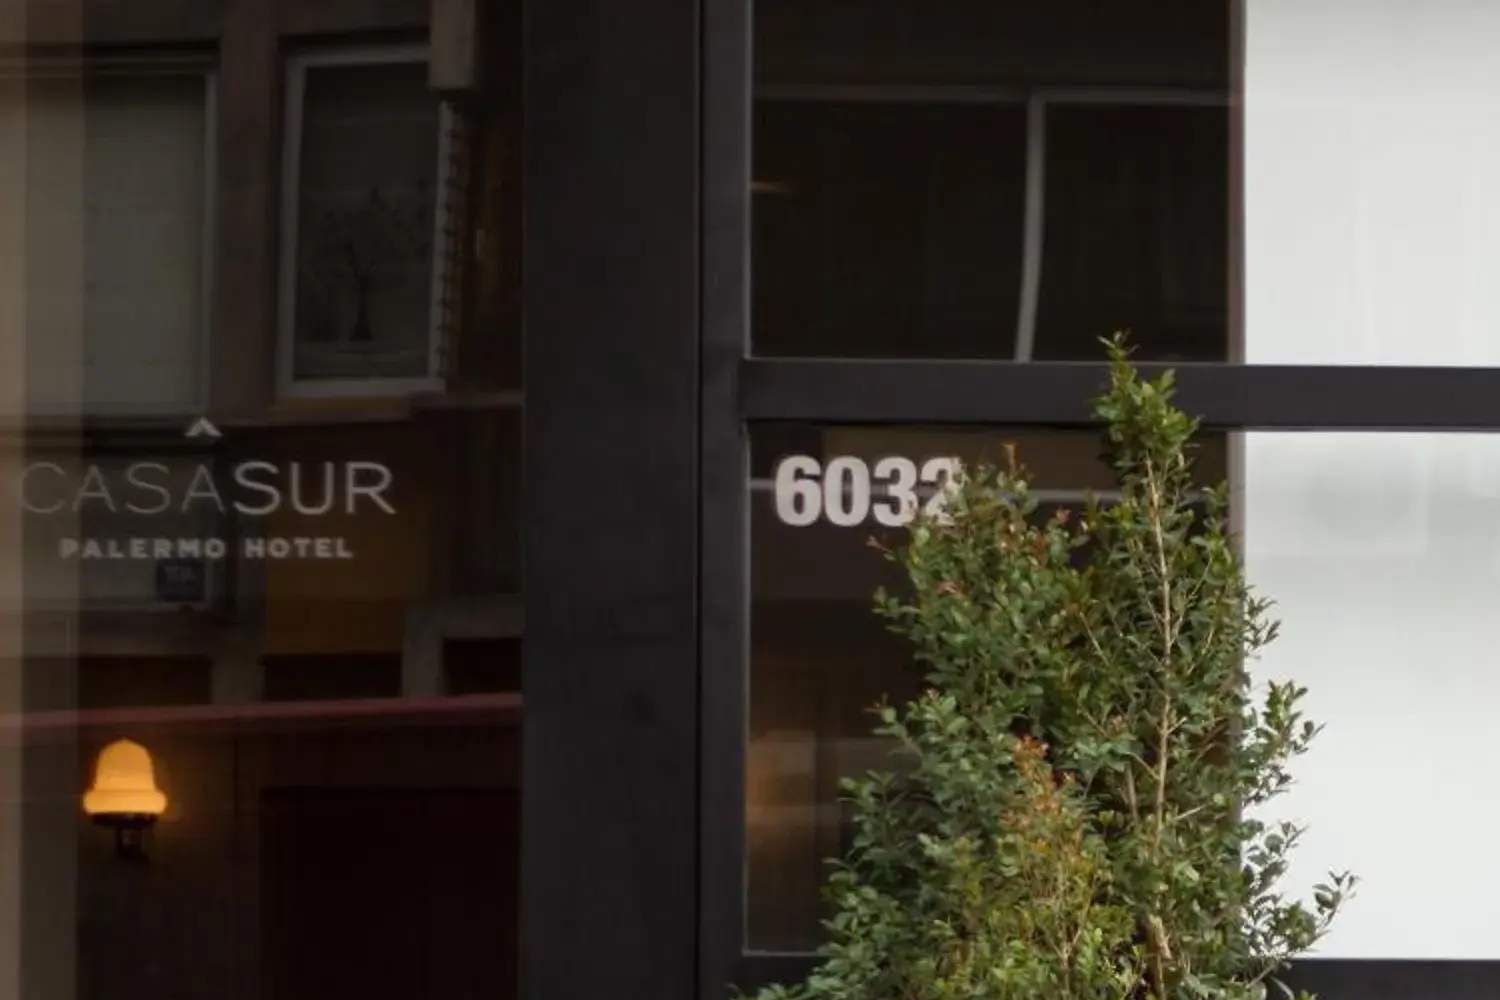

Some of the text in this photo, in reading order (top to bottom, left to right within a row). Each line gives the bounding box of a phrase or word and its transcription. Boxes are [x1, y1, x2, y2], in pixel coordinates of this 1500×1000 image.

[20, 461, 397, 515] CASASUR
[59, 538, 354, 559] PALERMO HOTEL
